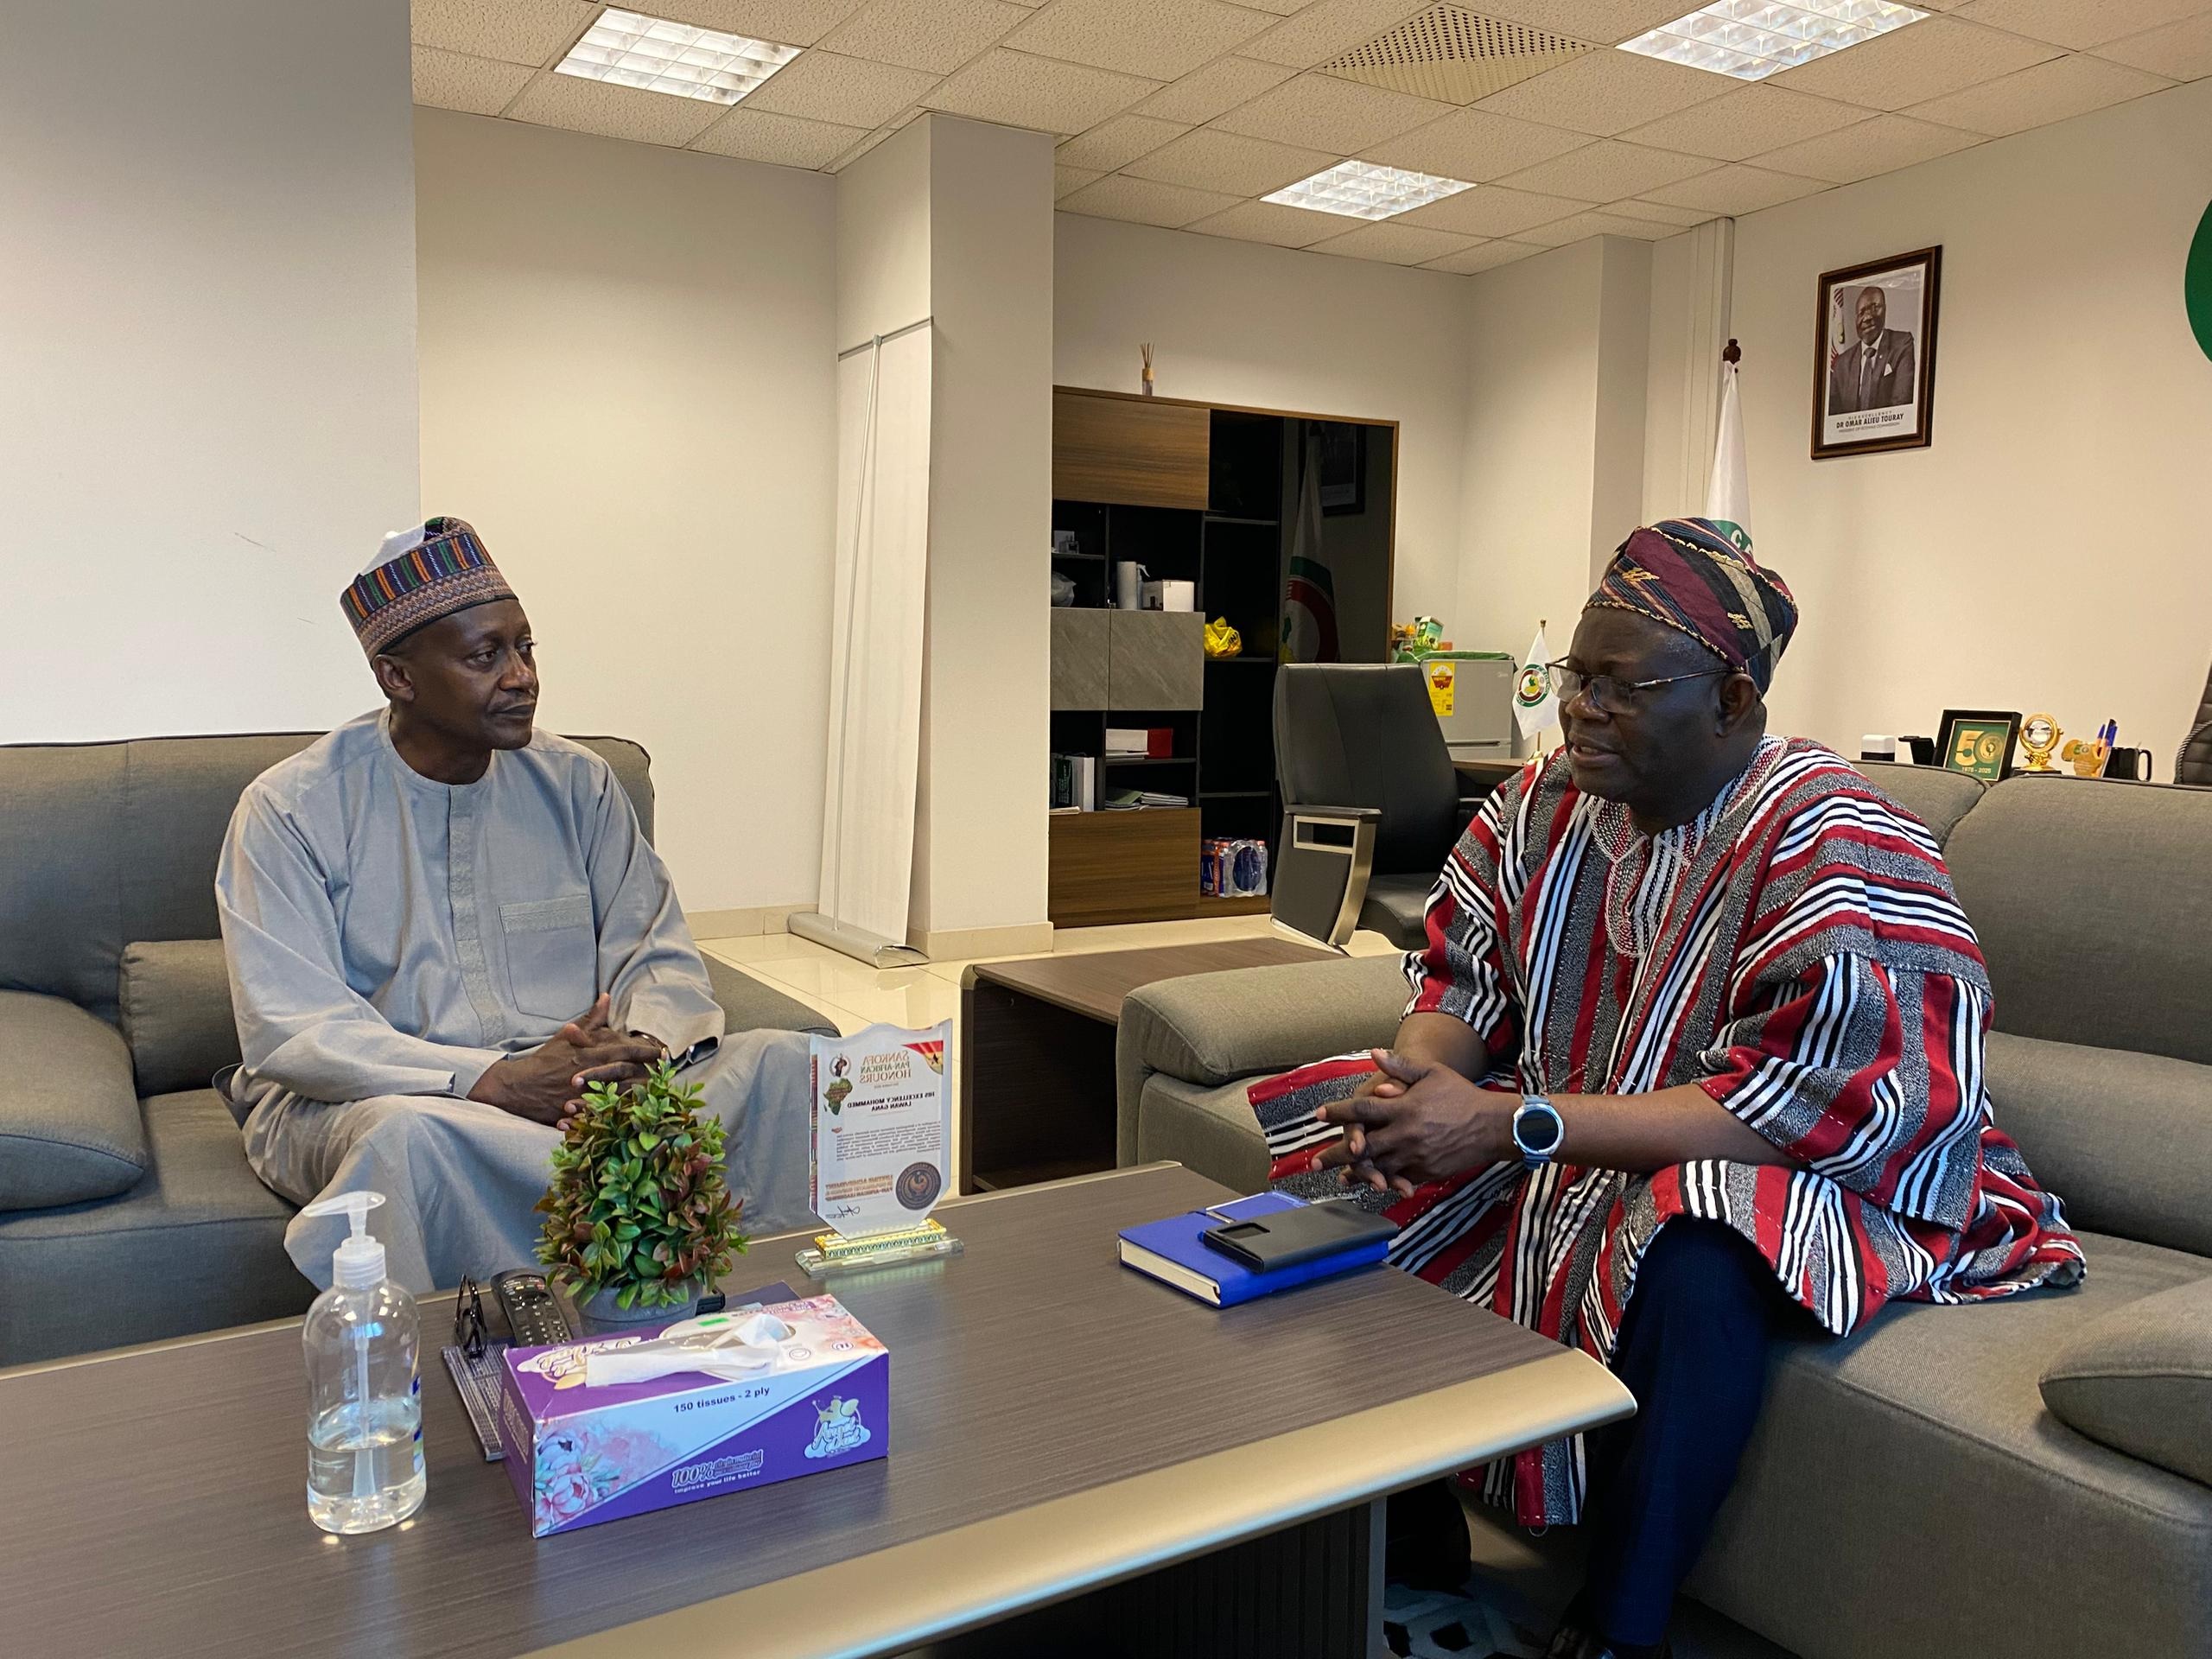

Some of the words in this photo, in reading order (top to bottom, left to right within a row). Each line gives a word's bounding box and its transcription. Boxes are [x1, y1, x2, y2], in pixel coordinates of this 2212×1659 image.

[1845, 419, 1862, 428] OMAR
[1863, 416, 1880, 425] ALIEU
[1881, 413, 1904, 423] TOURAY
[674, 1402, 693, 1413] 150
[696, 1395, 735, 1408] tissues
[745, 1389, 751, 1398] 2
[754, 1387, 770, 1398] ply
[673, 1462, 714, 1486] 100%
[723, 1475, 736, 1484] life
[738, 1470, 760, 1478] better
